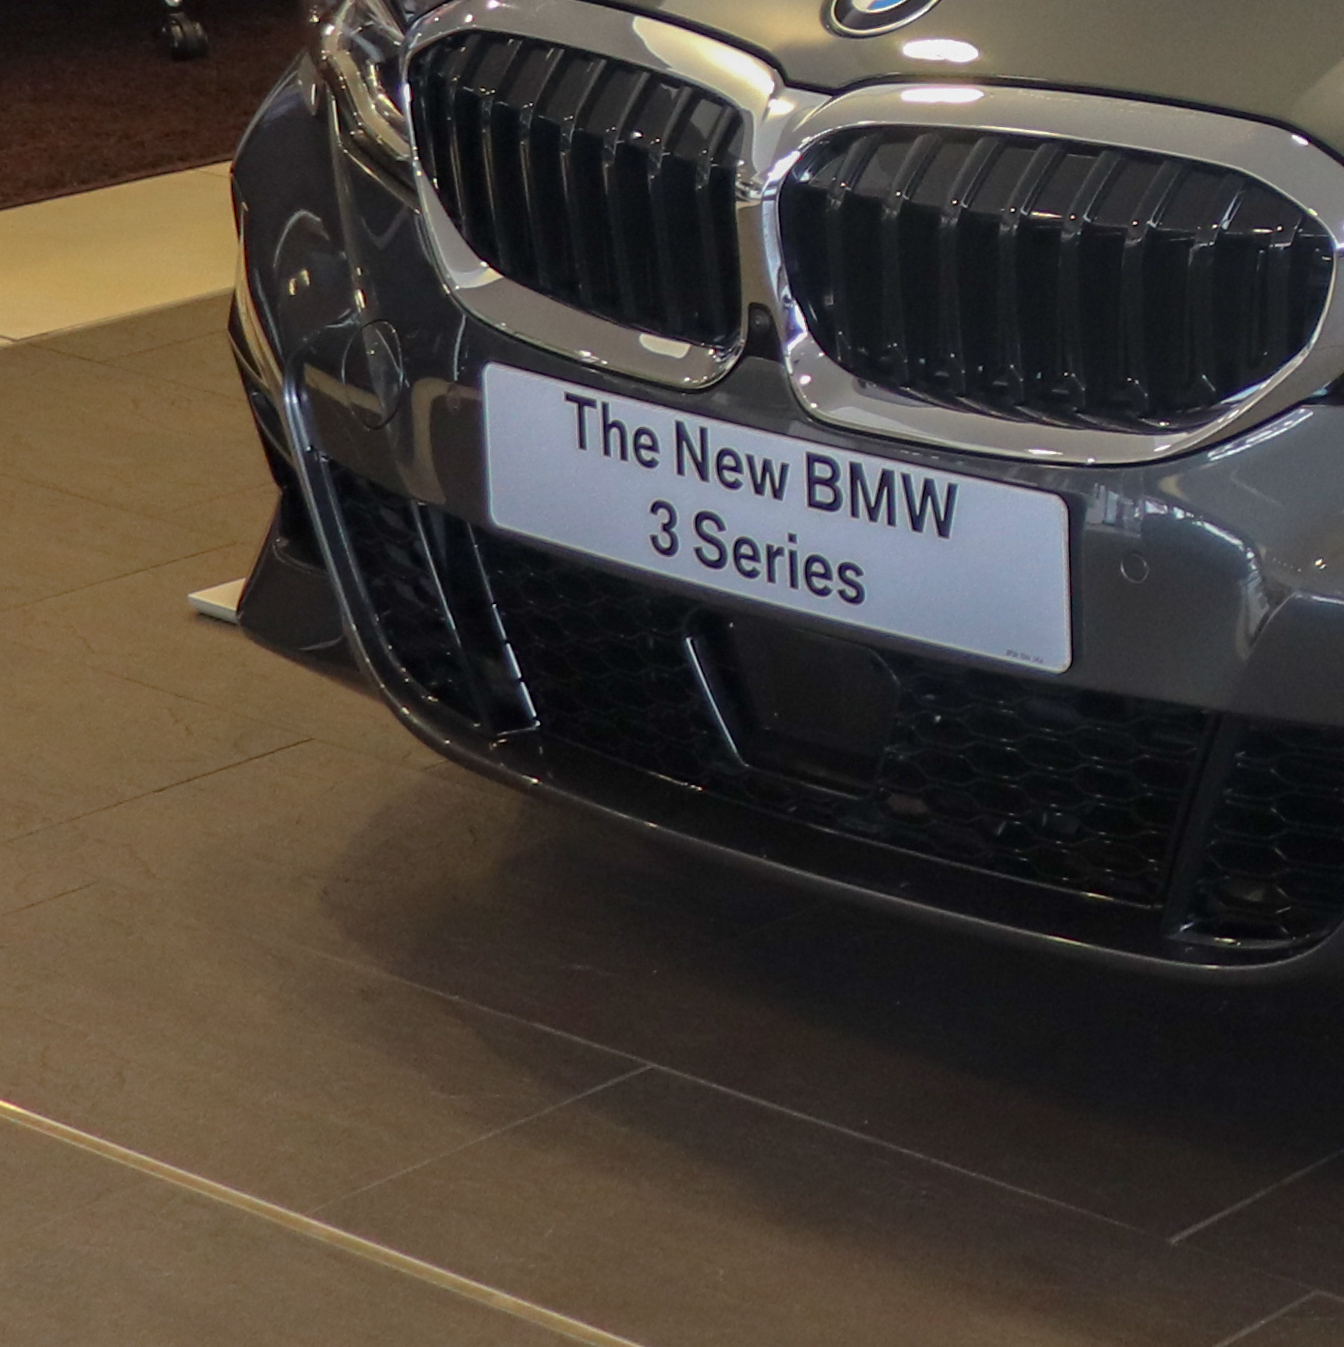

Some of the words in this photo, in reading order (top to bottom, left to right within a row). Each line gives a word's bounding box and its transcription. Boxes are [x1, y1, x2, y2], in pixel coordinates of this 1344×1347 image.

[564, 391, 659, 469] The
[673, 419, 790, 501] New
[804, 451, 958, 540] BMW
[648, 499, 679, 557] 3
[693, 510, 867, 606] Series
